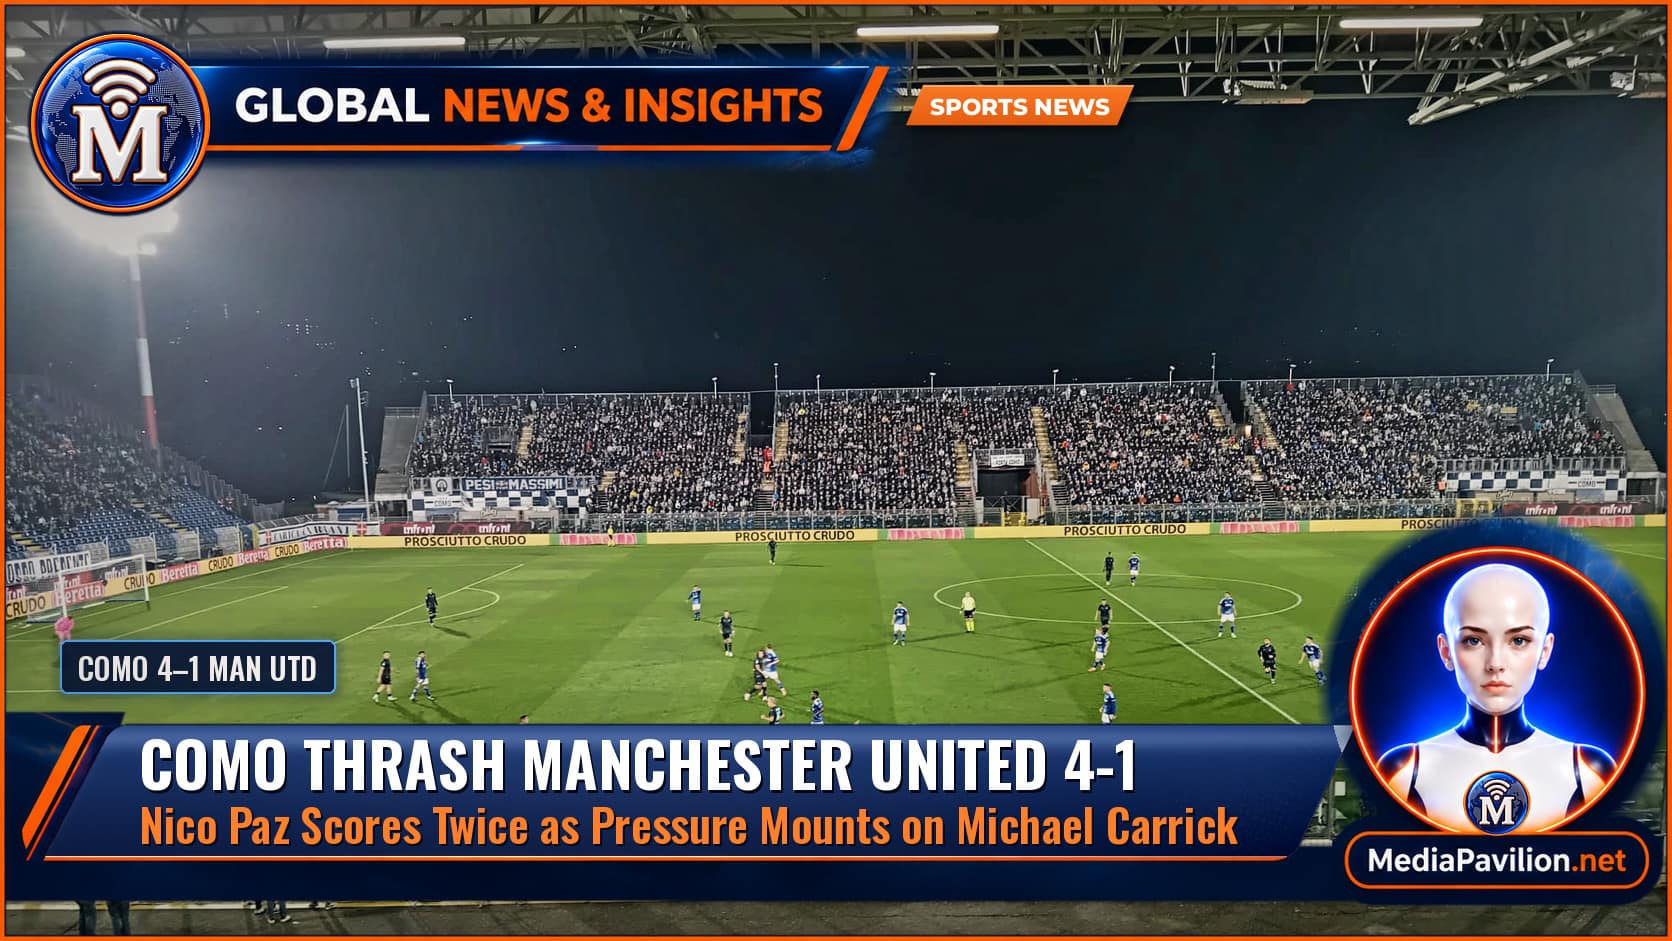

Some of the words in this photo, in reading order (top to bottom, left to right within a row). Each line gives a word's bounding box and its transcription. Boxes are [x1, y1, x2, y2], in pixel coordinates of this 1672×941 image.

[465, 479, 496, 490] PESI
[508, 478, 563, 490] MASSIMI
[735, 531, 811, 542] PROSCIUTTO
[813, 530, 855, 540] CRUDO
[1064, 525, 1141, 536] PROSCIUTTO
[1143, 524, 1187, 535] CRUDO
[404, 535, 482, 547] PROSCIUTTO
[484, 535, 527, 545] CRUDO
[161, 562, 198, 583] Beretta
[208, 556, 234, 571] CRUDO
[274, 543, 300, 557] CRUDO
[303, 537, 345, 552] Beretta
